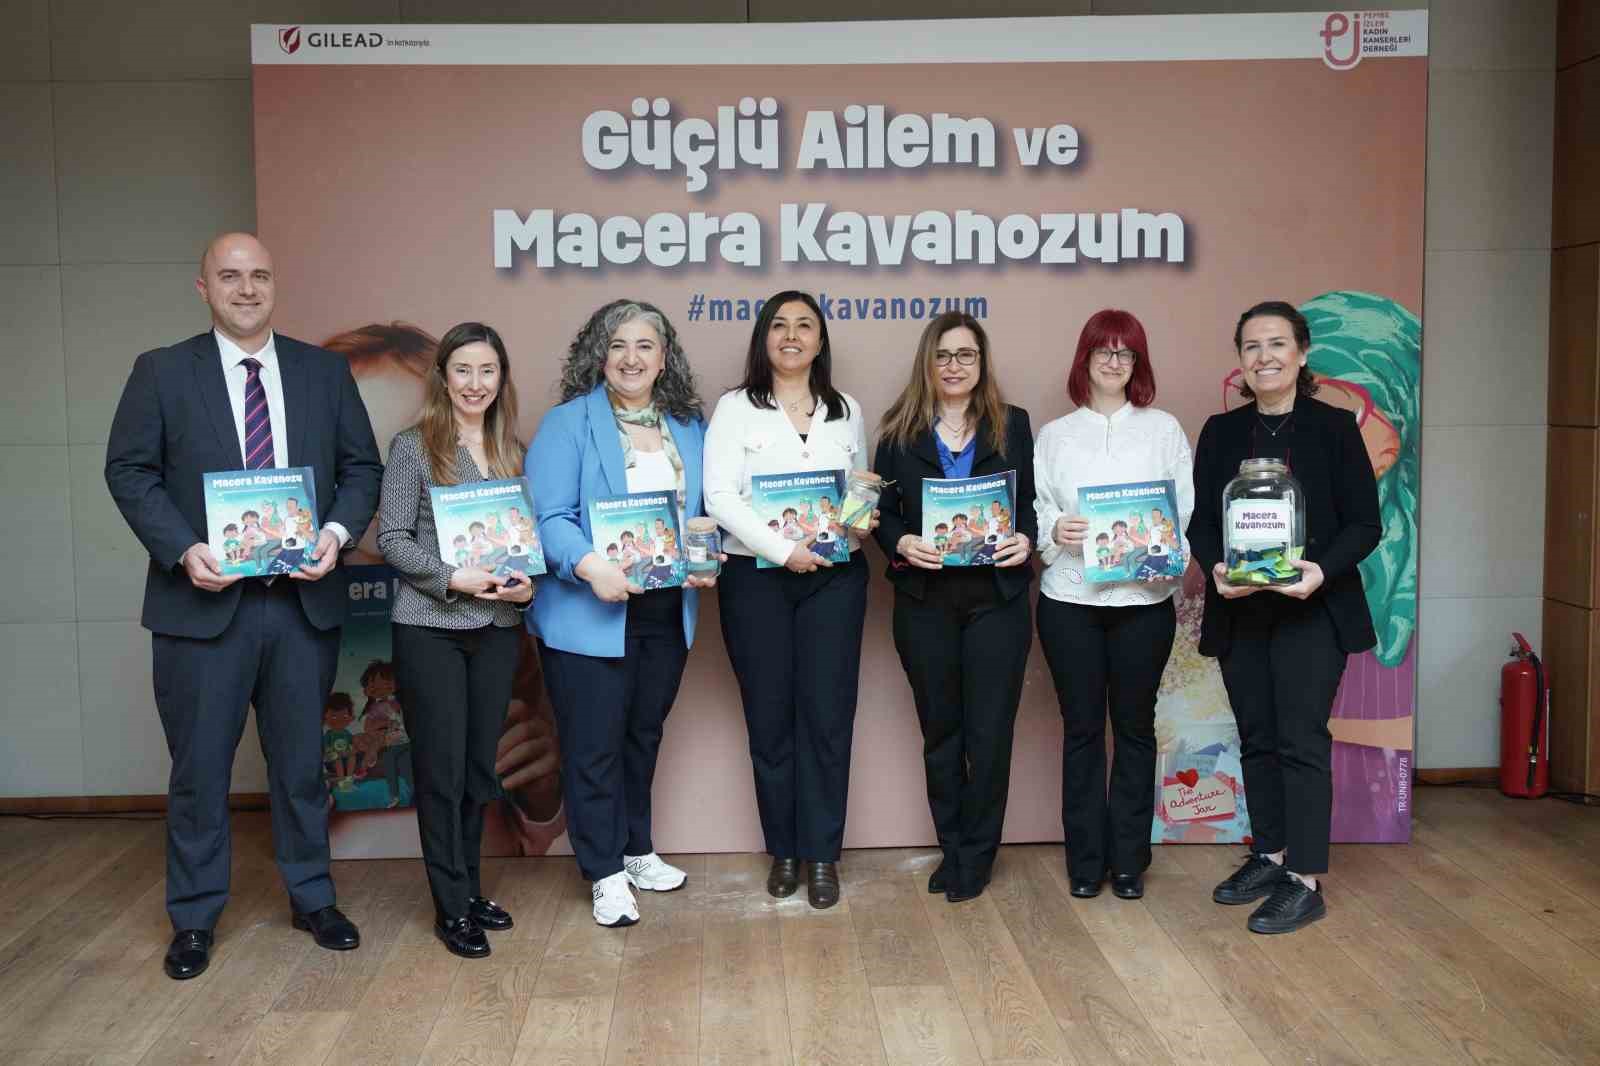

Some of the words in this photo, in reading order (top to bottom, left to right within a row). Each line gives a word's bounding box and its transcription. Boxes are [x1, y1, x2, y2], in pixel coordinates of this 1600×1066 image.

[307, 33, 383, 48] GILEAD
[1363, 35, 1411, 44] KANSERLERİ
[1363, 44, 1398, 53] DERNEĞİ
[582, 97, 779, 192] Güçlü
[797, 104, 995, 169] Ailem
[1013, 123, 1080, 167] ve
[493, 208, 761, 269] Macera
[780, 202, 1185, 267] Kavanozum
[1242, 512, 1277, 520] Macera
